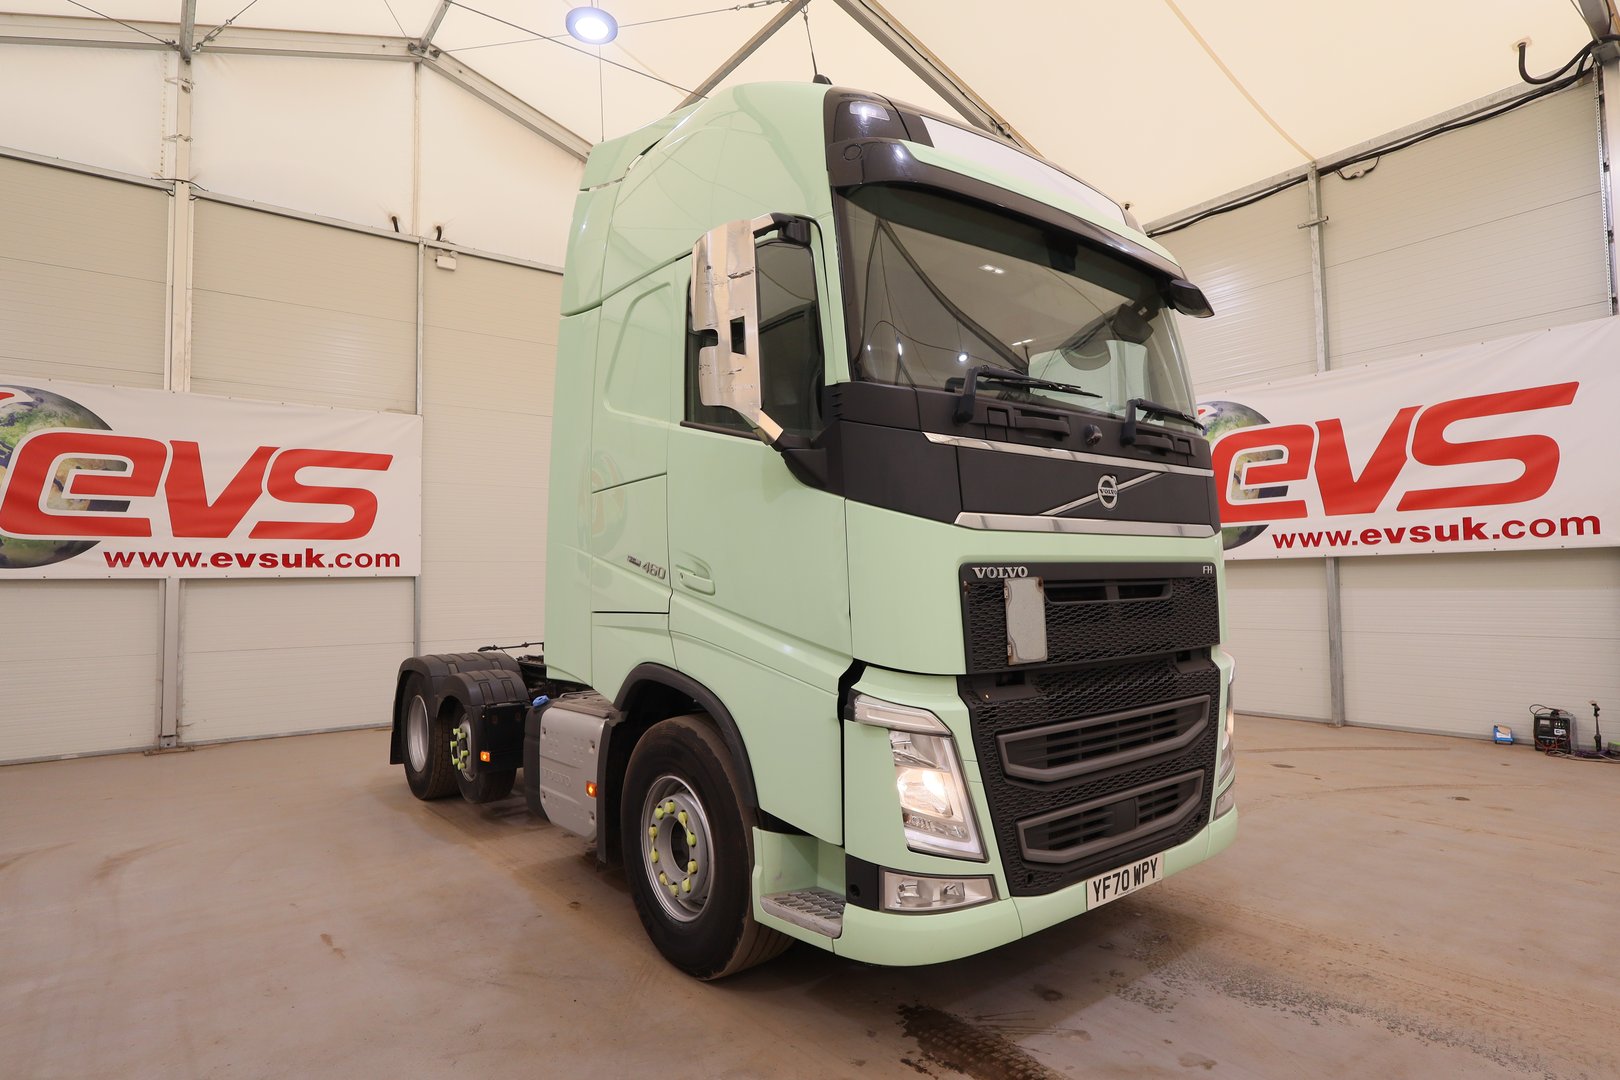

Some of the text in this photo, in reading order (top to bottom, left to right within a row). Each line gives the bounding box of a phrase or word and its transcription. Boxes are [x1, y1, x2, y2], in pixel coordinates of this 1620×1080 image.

[1272, 515, 1601, 549] www.evsuk.com
[103, 548, 401, 568] www.evsuk.com
[642, 562, 666, 579] 460
[972, 566, 1029, 578] VOLVO
[1202, 565, 1213, 575] FH
[1093, 857, 1158, 902] YF70 WPY
